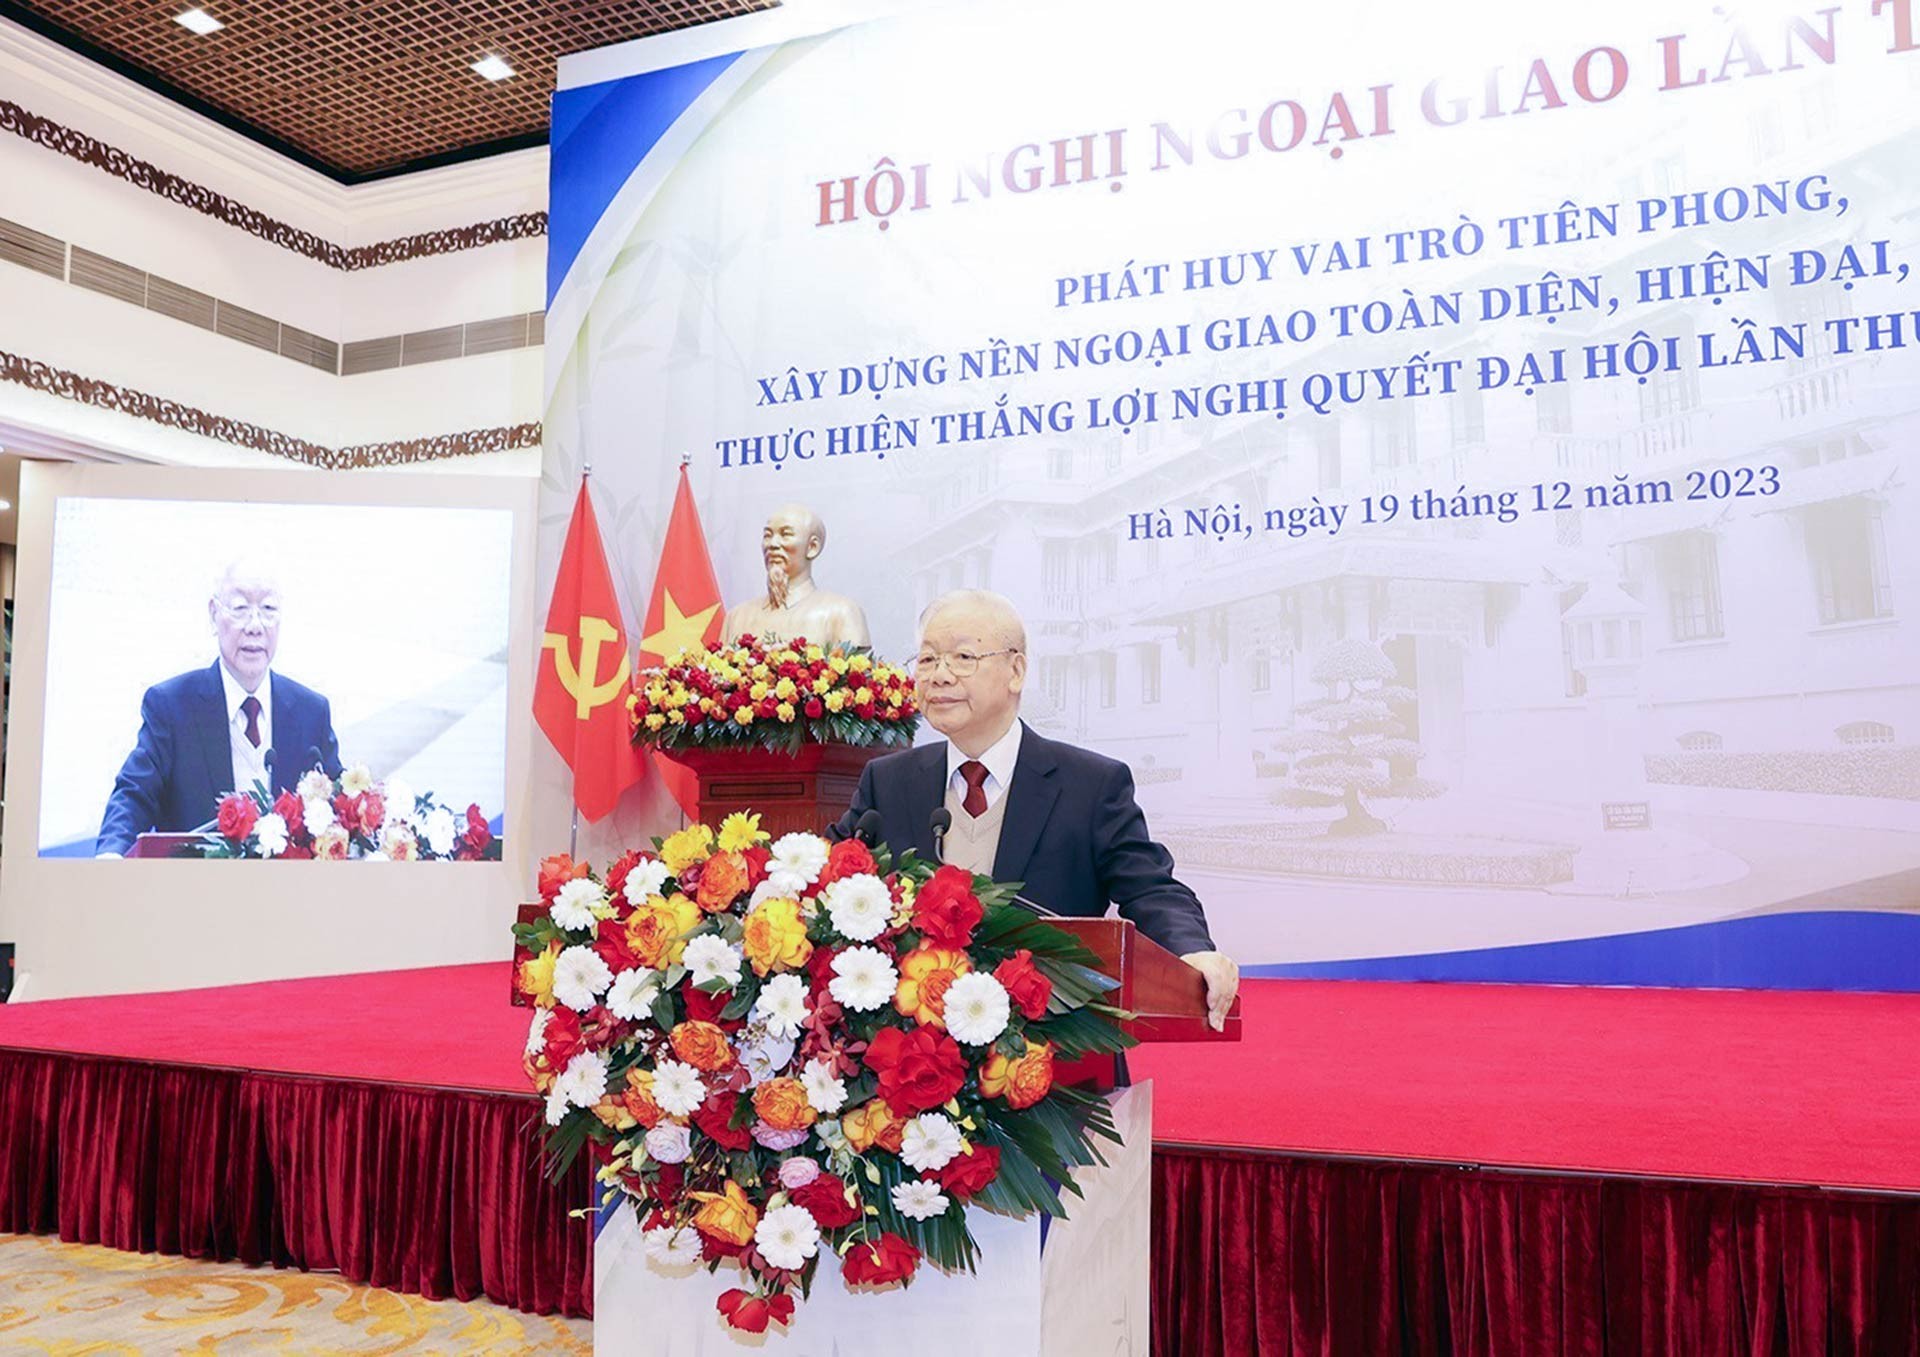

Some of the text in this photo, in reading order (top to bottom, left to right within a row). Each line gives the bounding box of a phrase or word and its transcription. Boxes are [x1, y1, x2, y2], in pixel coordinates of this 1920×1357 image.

[815, 156, 931, 231] HỘI
[952, 128, 1128, 204] NGHỊ
[1150, 84, 1395, 171] NGOẠI
[1420, 46, 1629, 127] GIAO
[1054, 175, 1850, 308] PHÁT HUY VAI TRÒ TIÊN PHONG,
[715, 310, 1920, 471] THỰC HIỆN THẮNG LỢI NGHỊ QUYẾT ĐẠI HỘI LẦN TH
[756, 240, 1909, 407] XÂY DỰNG NỀN NGOẠI GIAO TOÀN DIỆN, HIỆN ĐẠI,
[1127, 465, 1782, 542] Hà Nội, ngày 19 tháng 12 năm 2023
